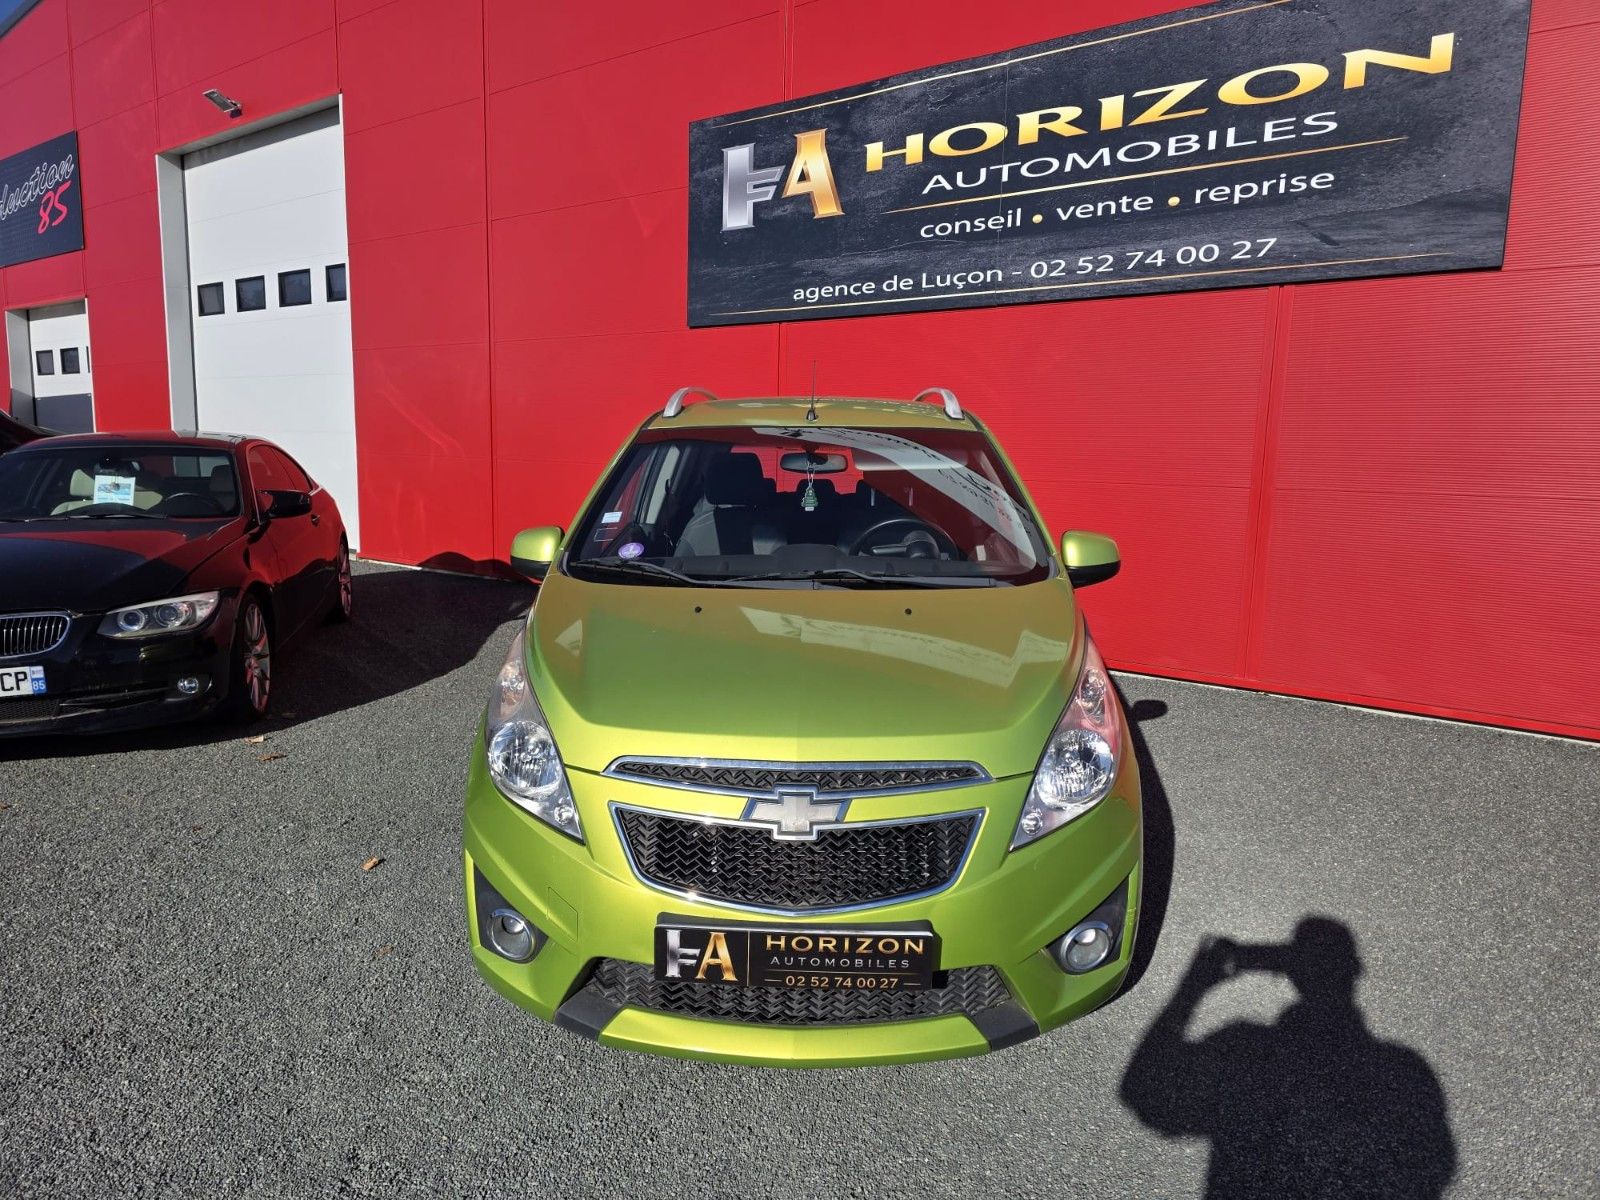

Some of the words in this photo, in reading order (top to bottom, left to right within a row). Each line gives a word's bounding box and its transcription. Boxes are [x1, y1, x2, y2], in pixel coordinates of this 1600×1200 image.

[863, 32, 1455, 174] HORIZON
[921, 111, 1338, 195] AUTOMOBILES
[38, 181, 72, 234] 85
[920, 207, 1023, 238] conseil
[1055, 195, 1154, 221] vente
[1193, 172, 1335, 206] reprise
[792, 281, 876, 303] agence
[882, 274, 914, 292] de
[920, 269, 1003, 290] Luçon
[1029, 258, 1066, 279] 02
[1075, 254, 1114, 275] 52
[1125, 248, 1166, 270] 74
[1175, 243, 1220, 265] 00
[1230, 237, 1278, 260] 27
[32, 680, 46, 691] 85
[765, 934, 925, 955] HORIZON
[770, 956, 911, 969] AUTOMOBILES
[785, 975, 806, 987] 02
[810, 976, 829, 988] 52
[834, 977, 852, 989] 74
[856, 977, 876, 989] 00
[879, 978, 899, 990] 27
